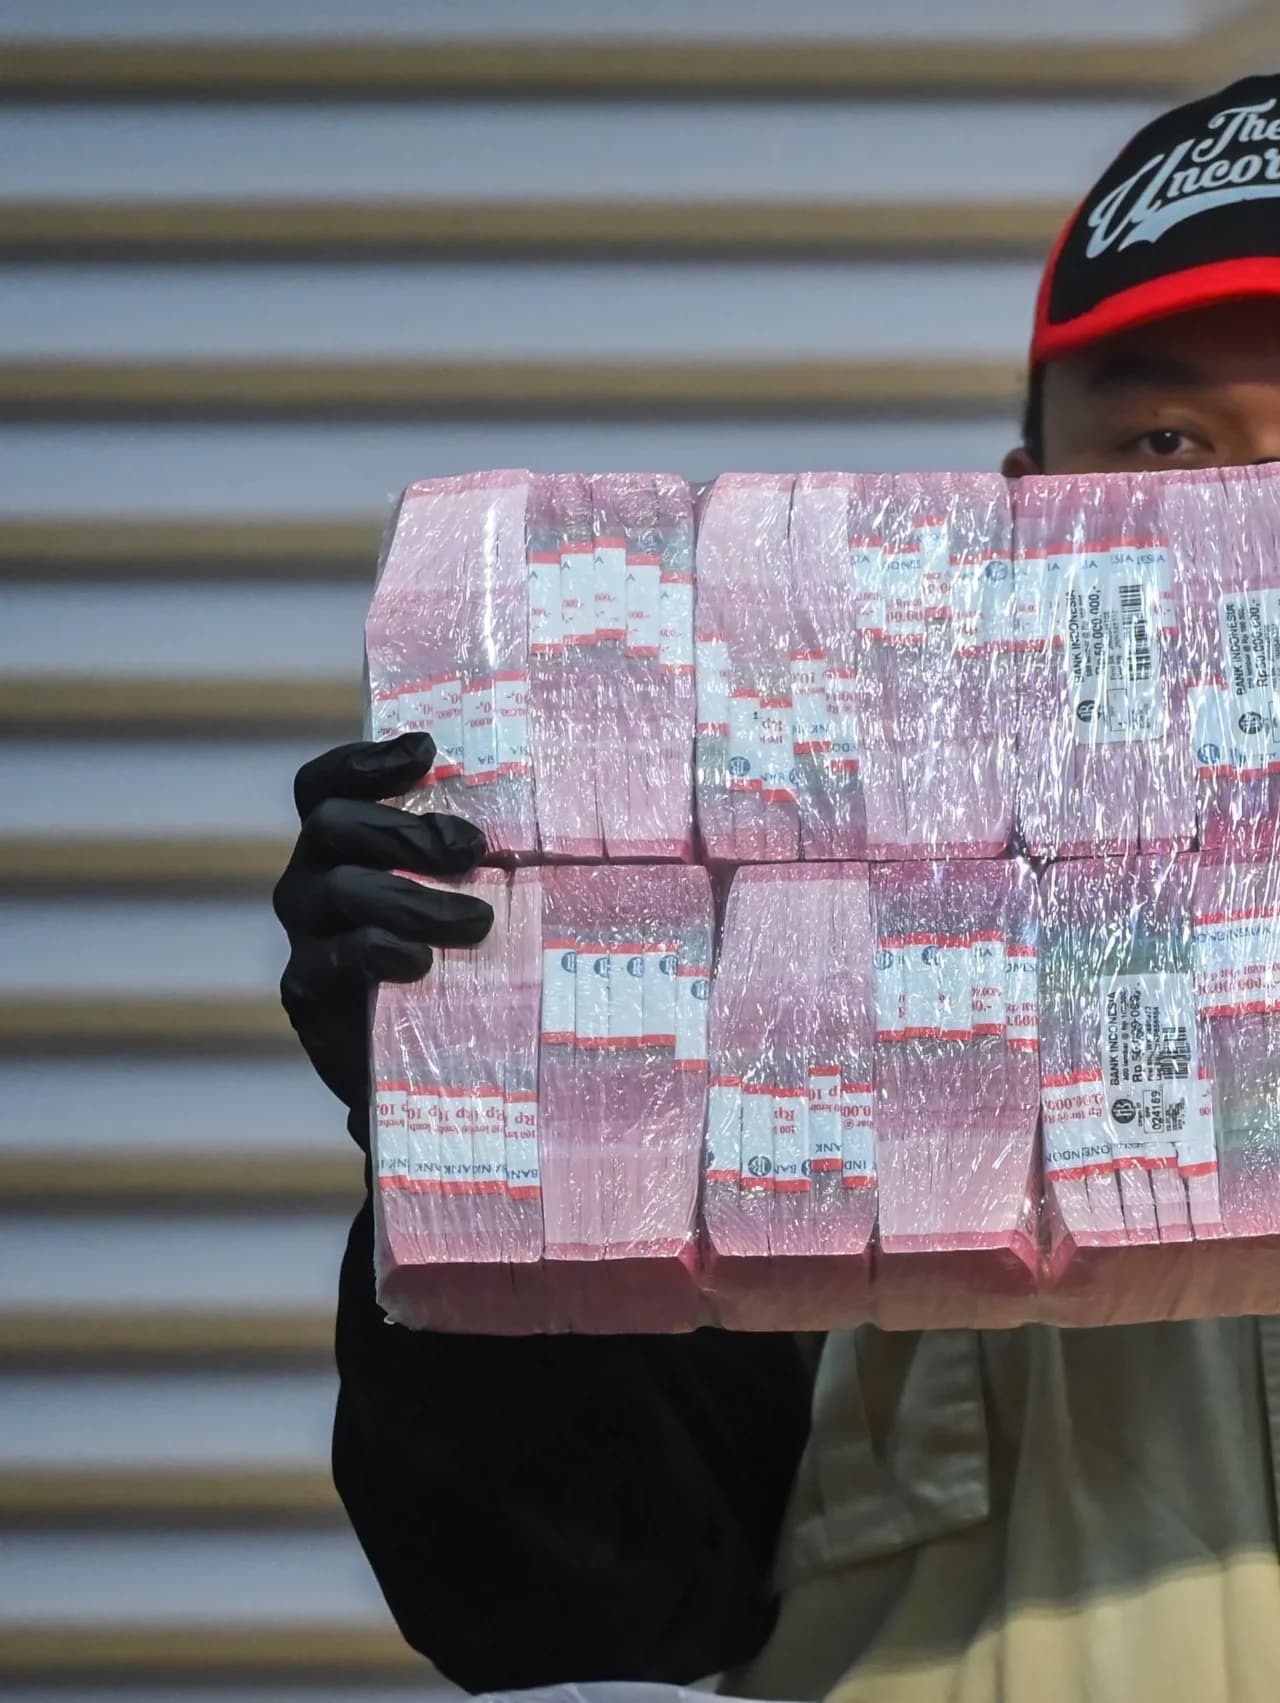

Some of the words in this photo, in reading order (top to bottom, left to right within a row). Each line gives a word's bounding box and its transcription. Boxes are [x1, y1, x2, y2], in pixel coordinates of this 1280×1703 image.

[1066, 590, 1080, 649] INDONESIA
[1088, 586, 1104, 656] 50.000.000,-
[1226, 603, 1241, 662] INDONESIA
[1249, 599, 1267, 668] 50.000.000,-
[1233, 665, 1247, 695] BANK
[1256, 669, 1268, 687] Rp
[1107, 992, 1119, 1052] INDONESIA
[1110, 1056, 1120, 1085] BANK
[1132, 1064, 1143, 1082] Rp
